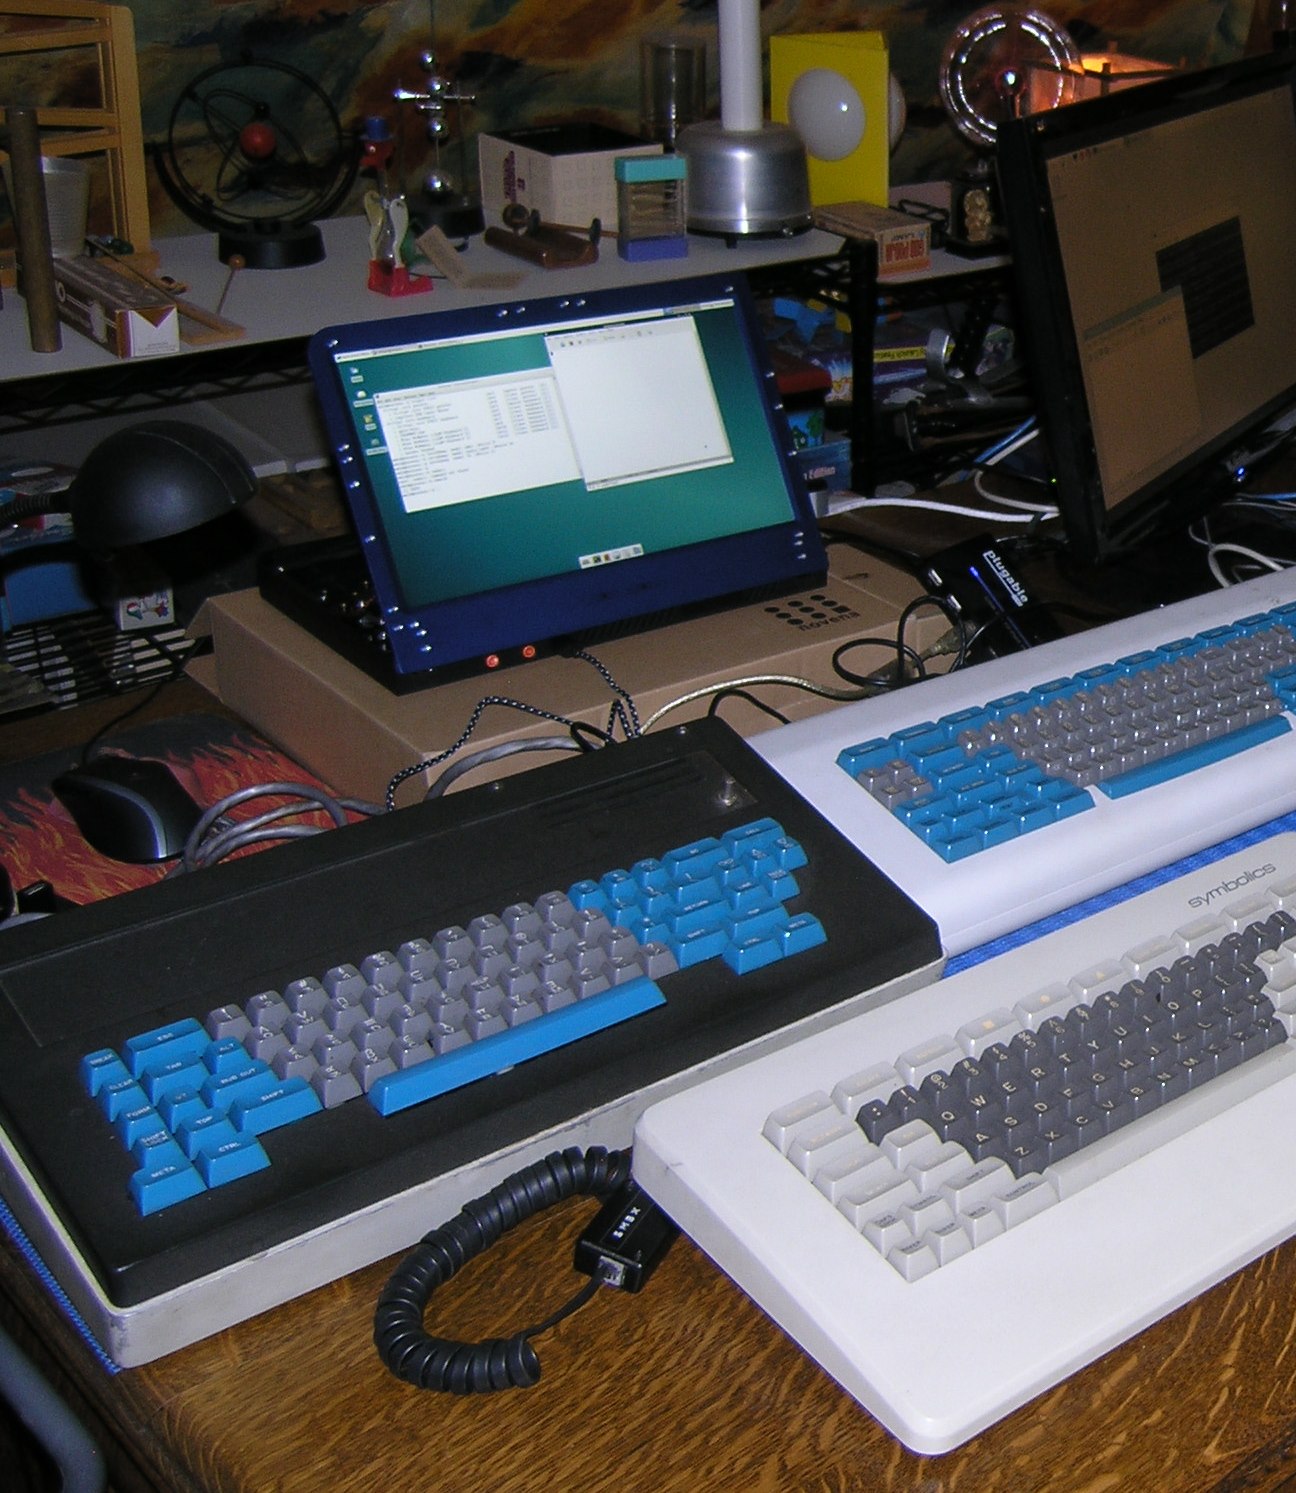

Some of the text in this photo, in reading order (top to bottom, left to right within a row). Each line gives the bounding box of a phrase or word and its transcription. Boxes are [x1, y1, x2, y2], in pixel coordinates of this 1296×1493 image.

[983, 550, 1028, 606] plugable
[798, 611, 860, 631] novena
[1188, 863, 1277, 909] symbolics
